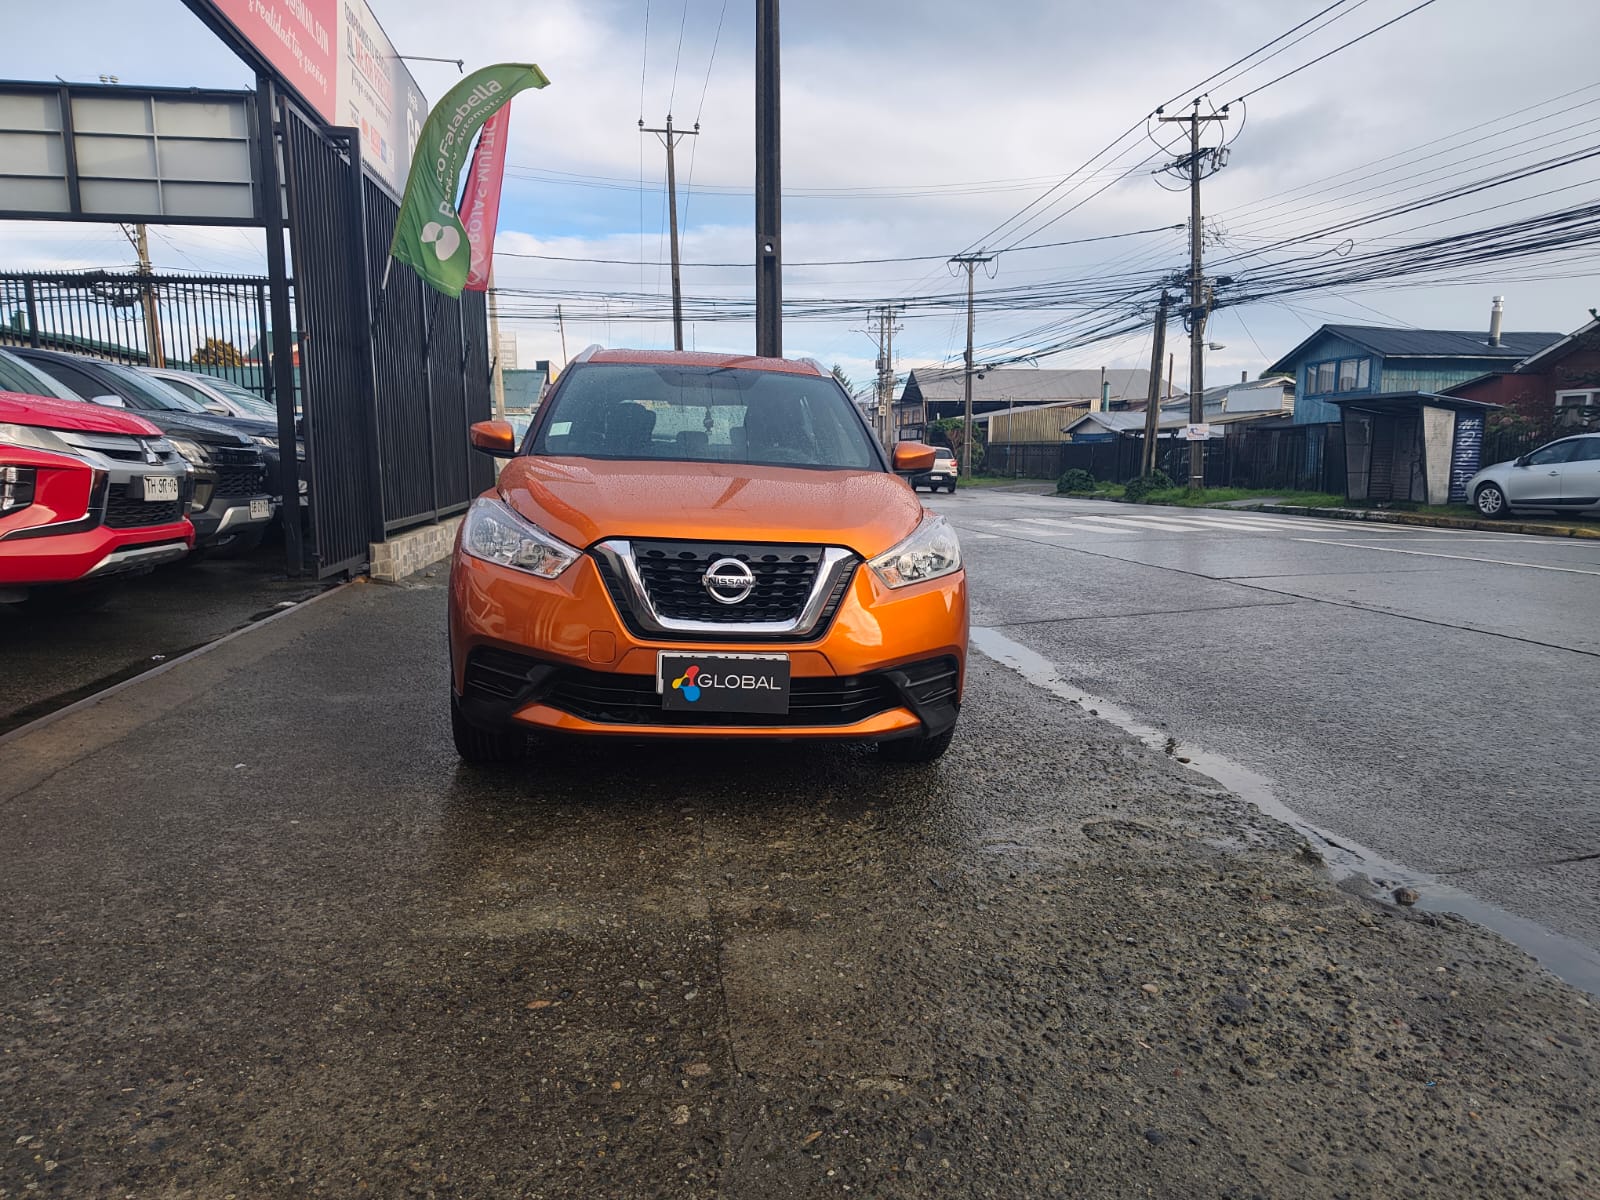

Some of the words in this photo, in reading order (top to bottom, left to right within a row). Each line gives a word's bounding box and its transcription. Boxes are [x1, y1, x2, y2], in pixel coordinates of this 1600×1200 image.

[440, 79, 503, 157] Falabella
[708, 577, 751, 586] NISSAN
[697, 673, 782, 690] GLOBAL
